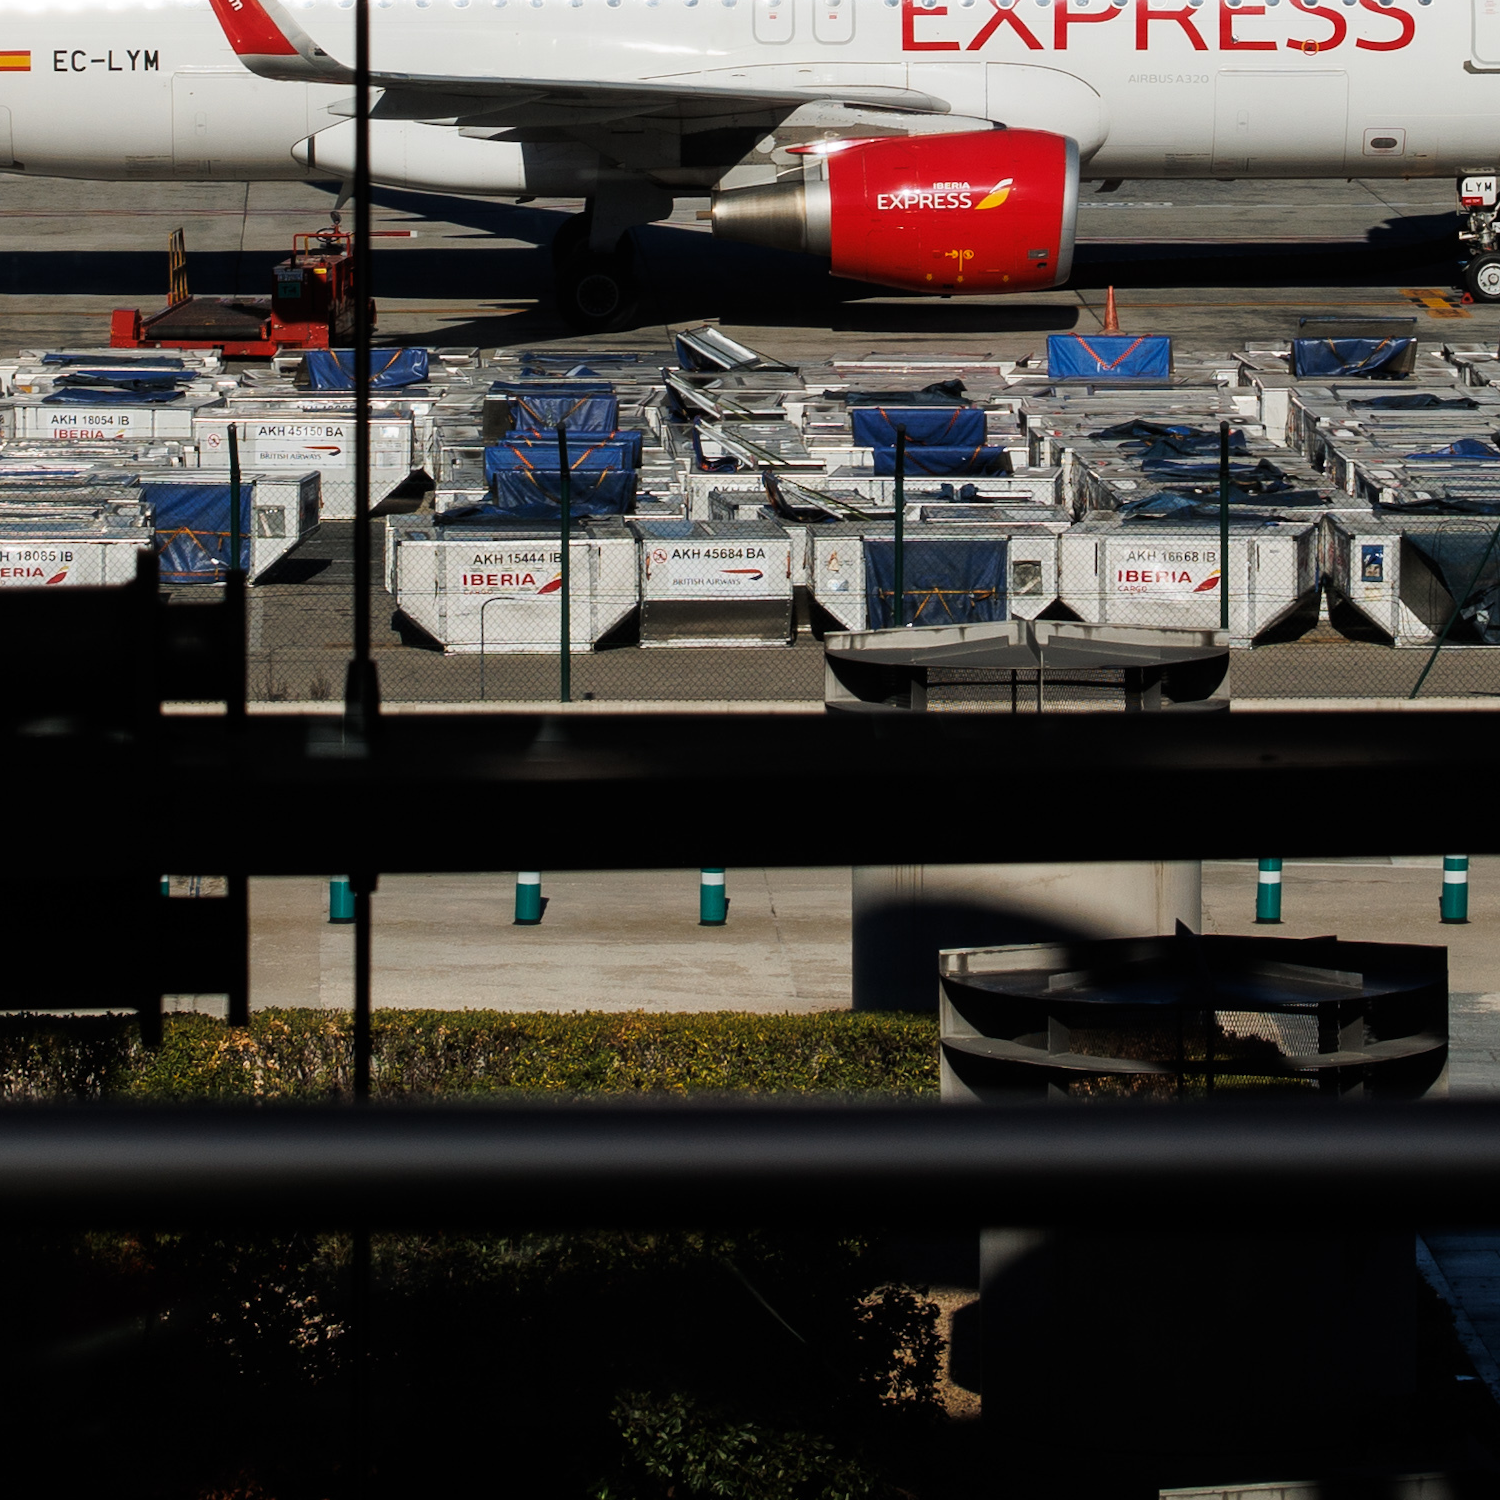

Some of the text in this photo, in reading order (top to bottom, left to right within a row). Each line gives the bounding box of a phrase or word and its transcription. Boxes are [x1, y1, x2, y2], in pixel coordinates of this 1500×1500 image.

[53, 50, 160, 72] EC-LYM
[1127, 74, 1210, 84] AIRBUS A320
[932, 181, 971, 190] IBERIA
[1465, 182, 1492, 192] LYM
[877, 192, 972, 210] EXPRESS
[51, 414, 130, 425] AKH 18054 IB
[54, 428, 104, 439] IBERIA
[258, 426, 344, 437] AKH 45150 BA
[259, 452, 322, 460] BRITISH AIRWAYS
[17, 550, 56, 562] 18085
[60, 550, 74, 562] IB
[473, 553, 562, 565] AKH 15444 IB
[671, 547, 766, 560] AKH 45684 BA
[1126, 551, 1157, 562] AKH
[1202, 551, 1216, 562] IB
[462, 573, 536, 586] IBERIA
[673, 578, 741, 586] BRITISH AIRWAYS
[1118, 570, 1192, 583] IBERIA
